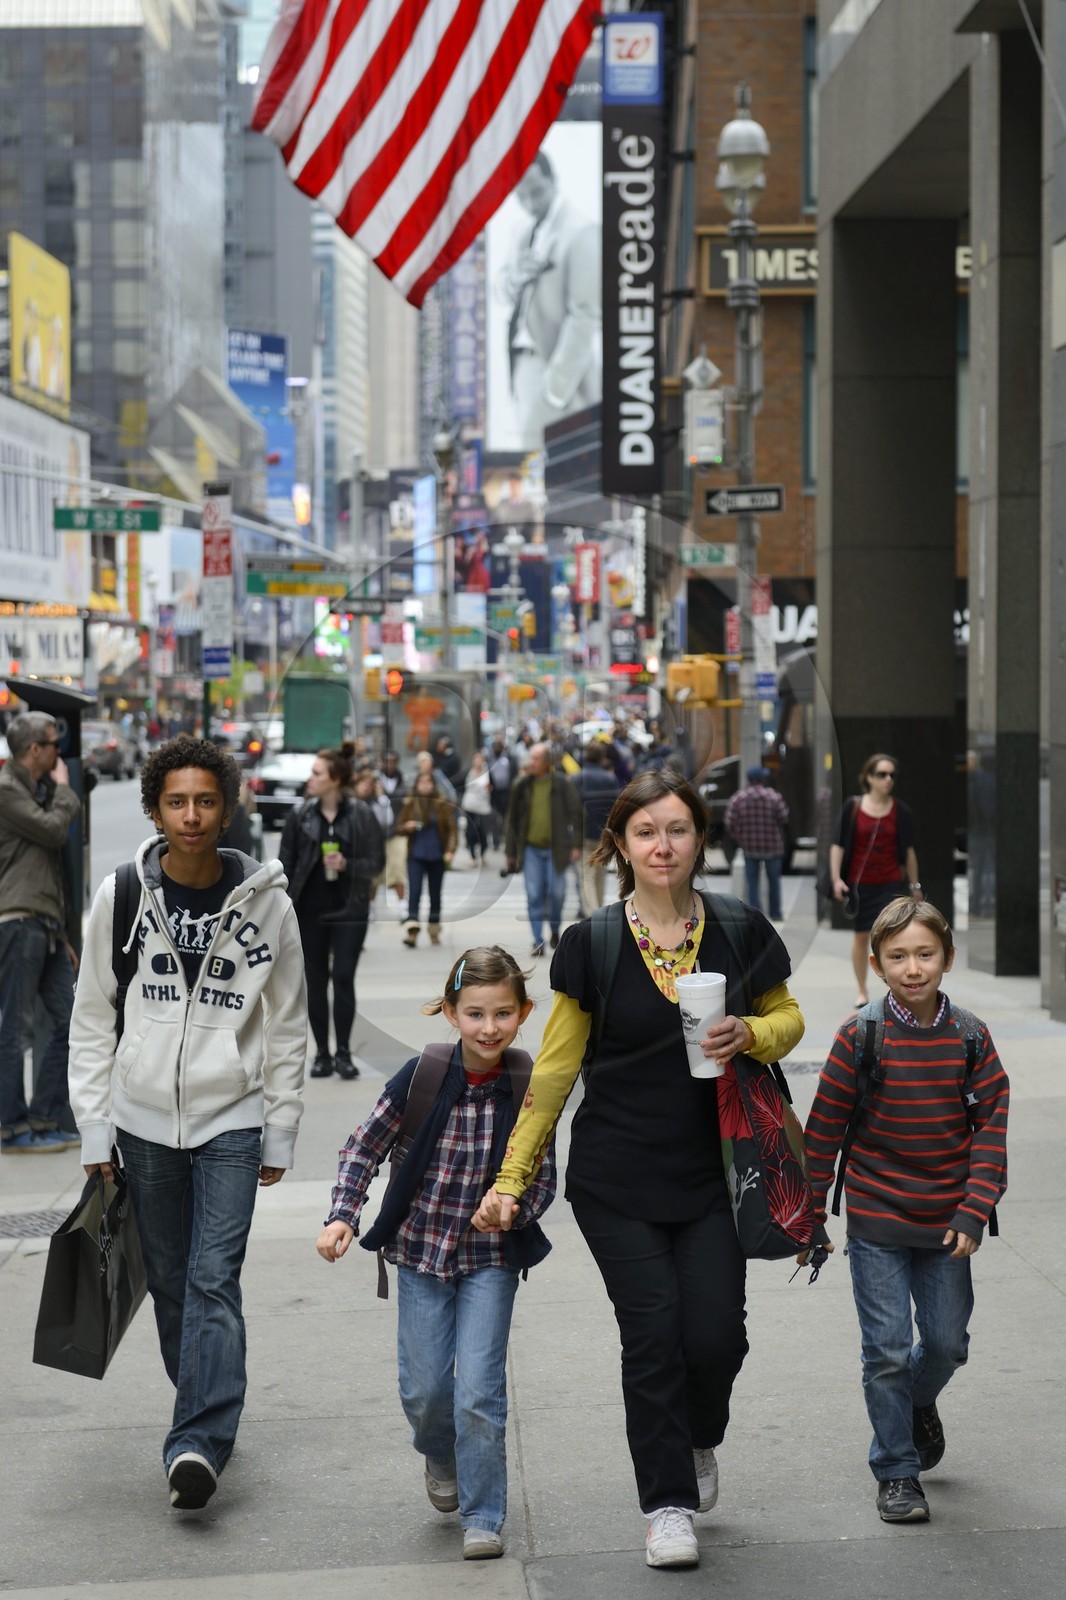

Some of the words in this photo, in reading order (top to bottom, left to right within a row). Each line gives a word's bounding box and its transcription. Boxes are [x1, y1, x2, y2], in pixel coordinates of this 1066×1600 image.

[718, 493, 737, 508] ONE
[751, 491, 775, 507] WAY
[72, 512, 89, 528] W
[92, 513, 117, 529] 52
[165, 954, 174, 972] 1
[211, 958, 224, 976] 8
